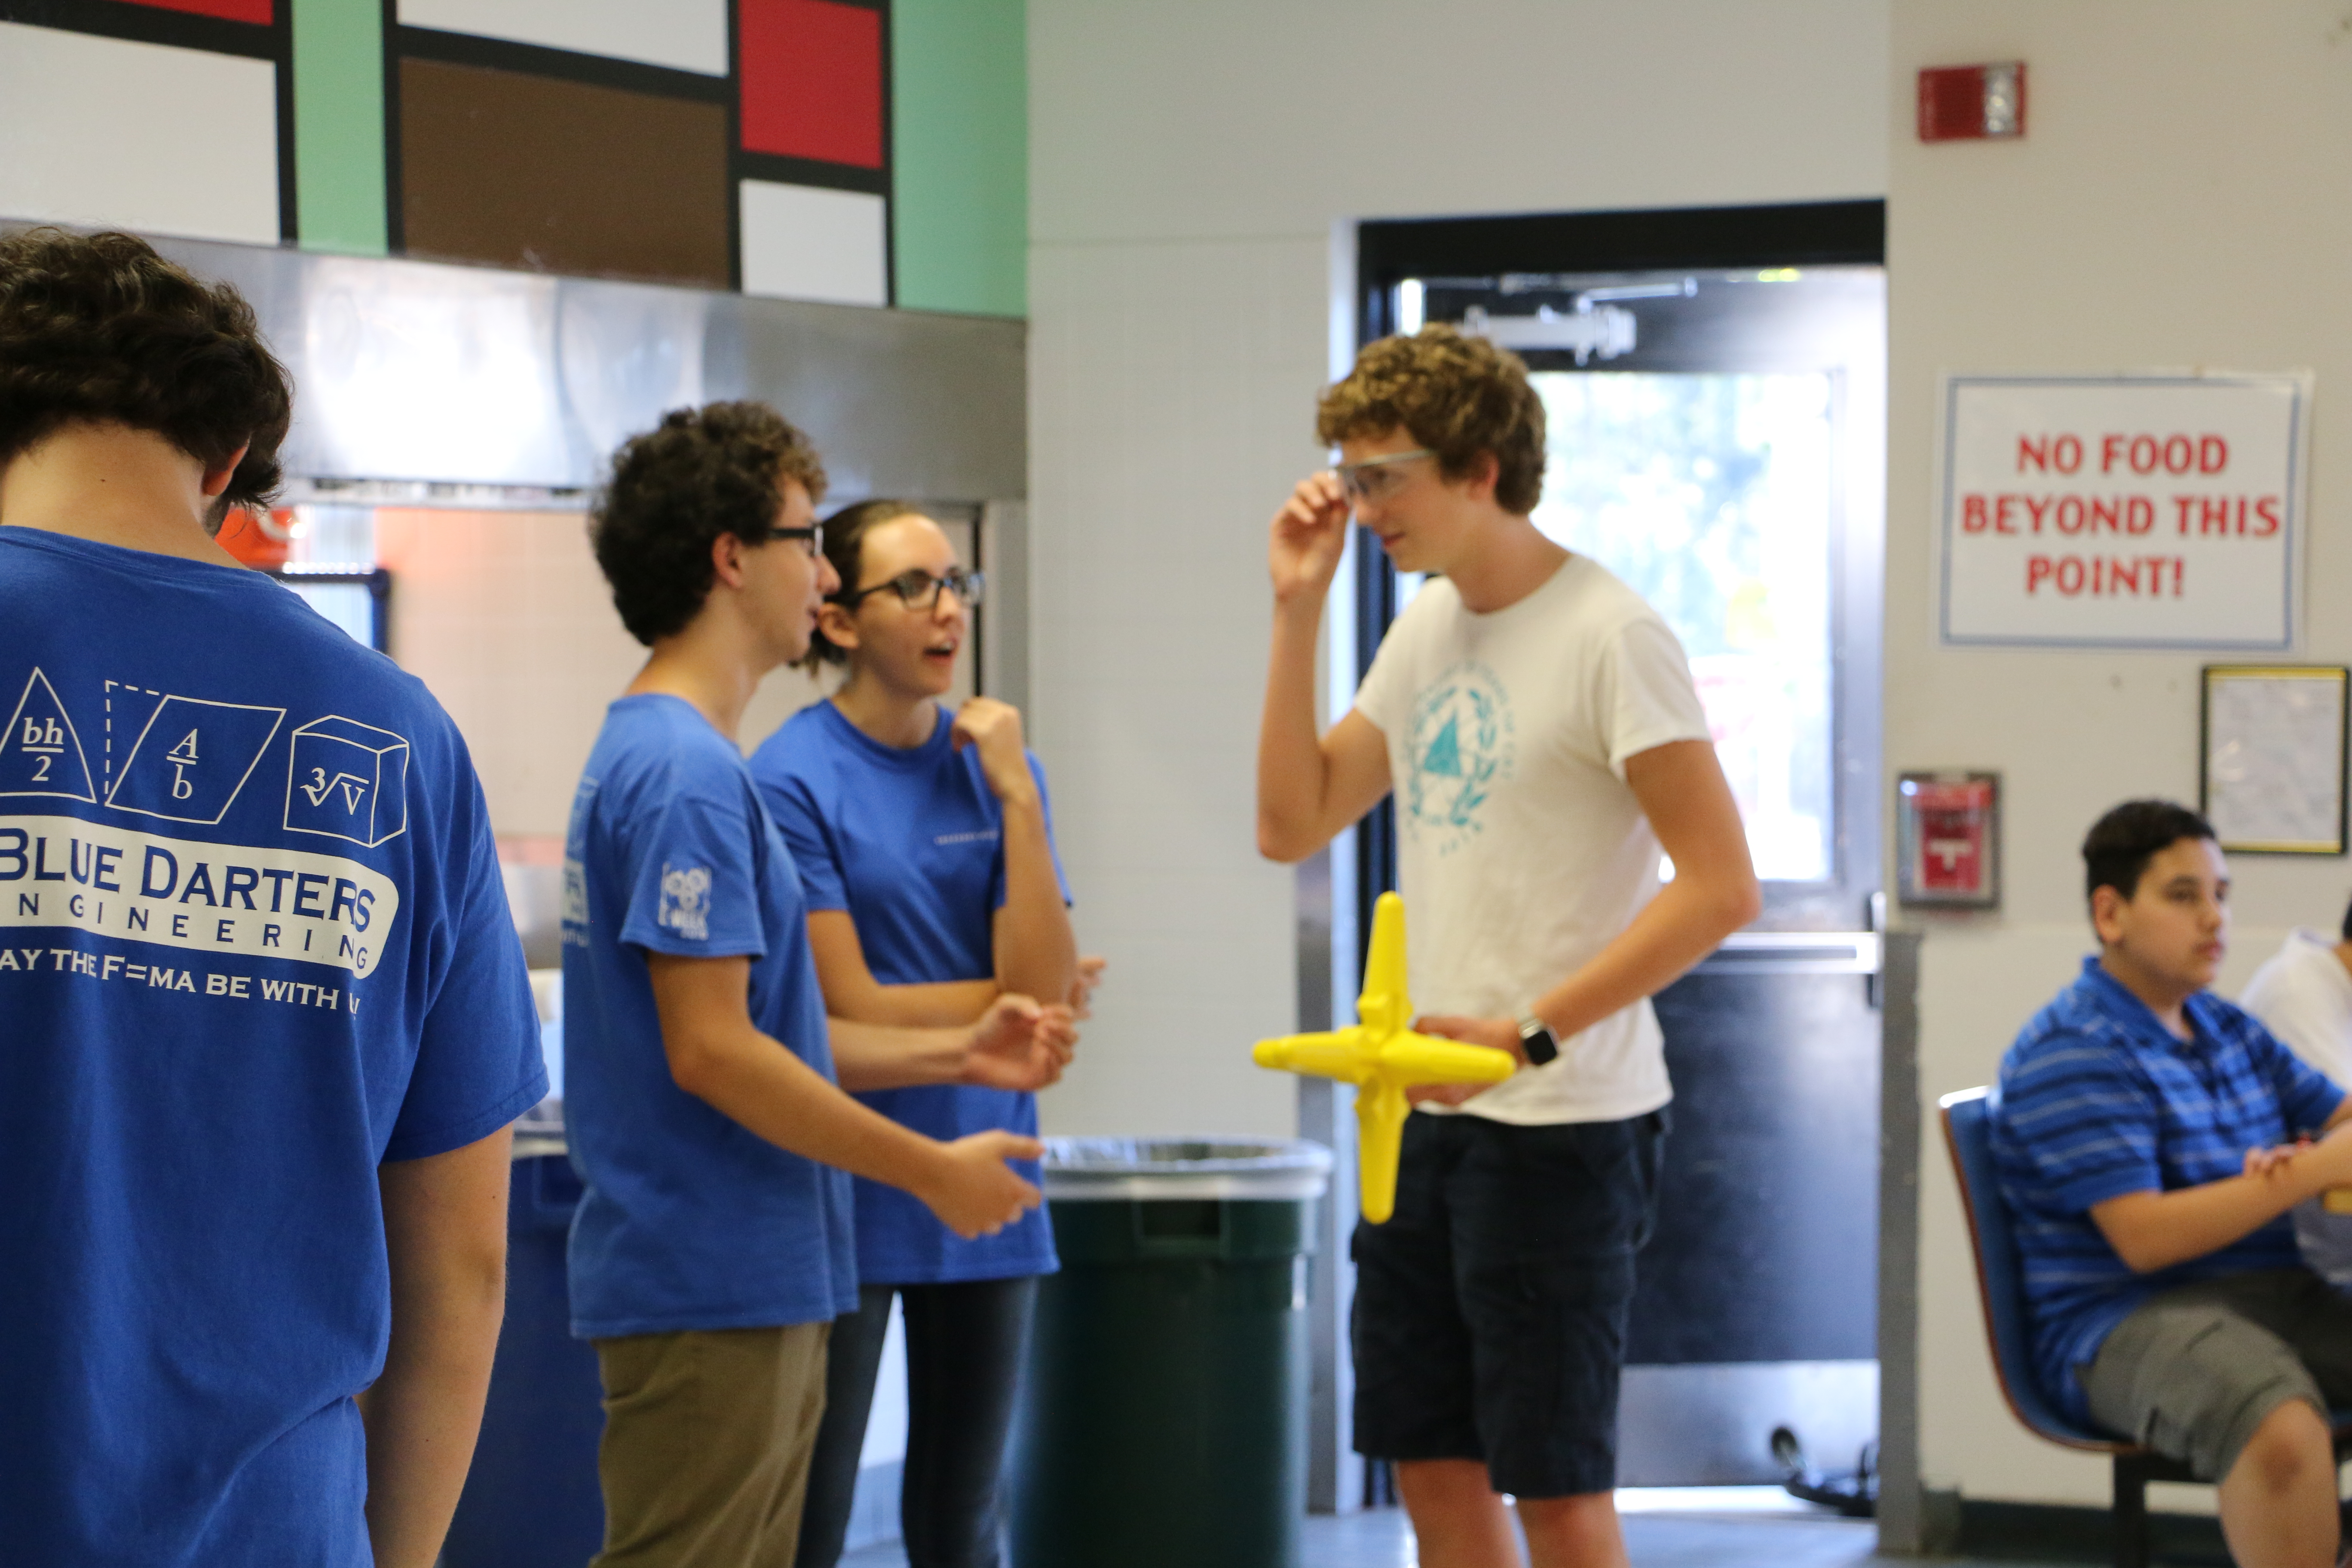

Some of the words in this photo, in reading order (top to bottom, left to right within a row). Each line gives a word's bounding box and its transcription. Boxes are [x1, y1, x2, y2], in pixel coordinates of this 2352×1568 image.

[2016, 433, 2084, 475] NO
[2101, 433, 2230, 476] FOOD
[1961, 493, 2156, 536] BEYOND
[2173, 494, 2281, 538] THIS
[2025, 554, 2185, 597] POINT!
[22, 717, 64, 745] bh
[168, 728, 199, 759] A
[31, 755, 52, 781] 2
[172, 763, 193, 799] b
[0, 828, 123, 894] BLUE
[139, 845, 375, 932] DARTERS
[18, 893, 368, 969] NGINEERING
[0, 949, 43, 971] AY
[50, 949, 97, 978] THE
[101, 955, 196, 993] F=MA
[205, 973, 251, 999] BE
[260, 978, 340, 1010] WITH
